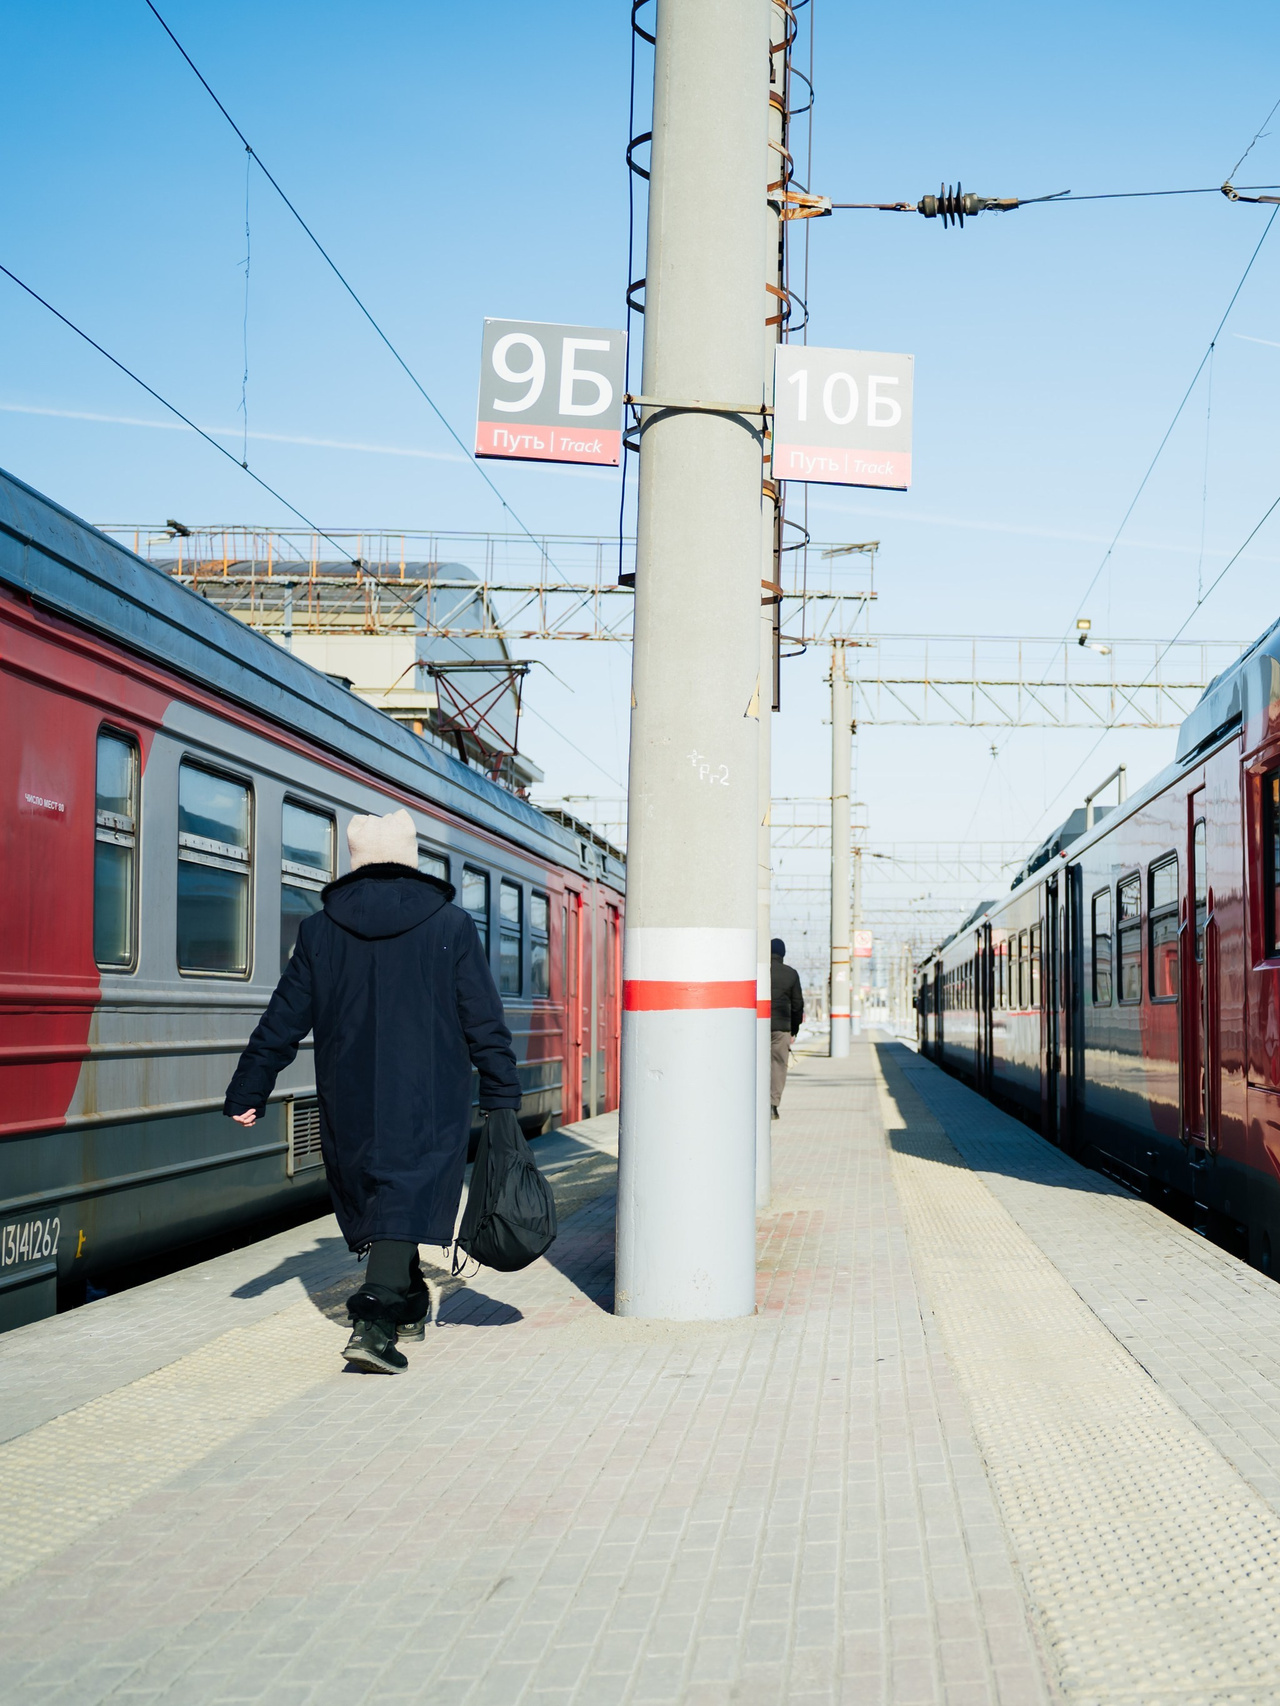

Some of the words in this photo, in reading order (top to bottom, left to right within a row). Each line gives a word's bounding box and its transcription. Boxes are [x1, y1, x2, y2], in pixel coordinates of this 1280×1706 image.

[491, 332, 613, 417] 9Б
[787, 368, 902, 428] 10Б
[492, 428, 545, 453] Путь
[559, 437, 603, 454] Track
[789, 450, 840, 474] Путь
[854, 460, 895, 475] Track
[1, 1216, 61, 1267] 13141262
